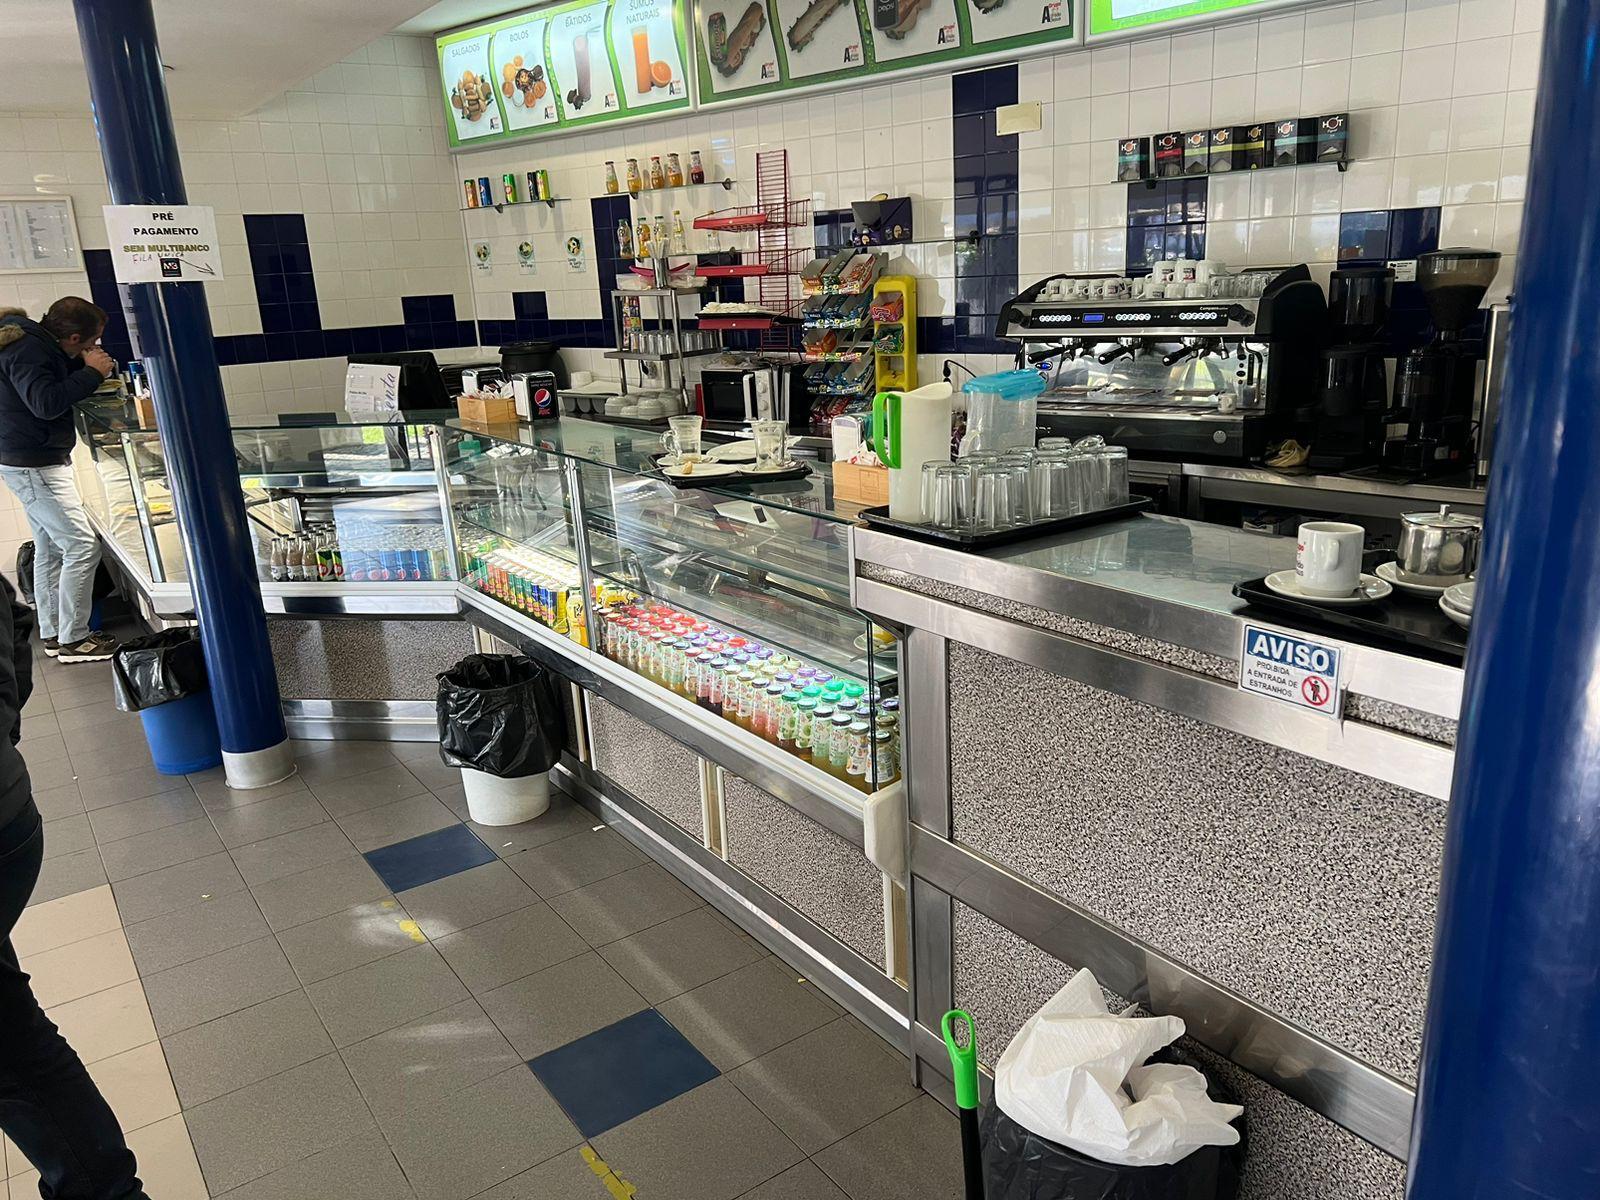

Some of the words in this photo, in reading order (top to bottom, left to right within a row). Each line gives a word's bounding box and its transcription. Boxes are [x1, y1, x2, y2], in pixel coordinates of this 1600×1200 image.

[565, 12, 592, 28] BATIDOS
[626, 7, 660, 24] NATURAIS
[1042, 6, 1051, 24] A
[509, 30, 529, 43] BOLOS
[937, 28, 946, 45] A
[451, 43, 480, 58] SALGADOS
[843, 47, 852, 63] A
[761, 64, 768, 79] A
[1277, 121, 1295, 135] HOT
[1322, 116, 1344, 129] HOT
[1159, 134, 1178, 146] HOT
[1188, 132, 1205, 144] HOT
[1213, 129, 1230, 142] HOT
[1121, 140, 1137, 152] HOT
[152, 211, 174, 221] PRÉ
[133, 227, 199, 235] PAGAMENTO
[123, 245, 145, 253] SEM
[147, 244, 210, 253] MULTIBANCO
[1252, 634, 1330, 672] AVISO
[1256, 660, 1290, 676] PROIBIDA
[1247, 668, 1253, 676] A
[1254, 669, 1287, 686] ENTRADA
[1288, 679, 1298, 689] DE
